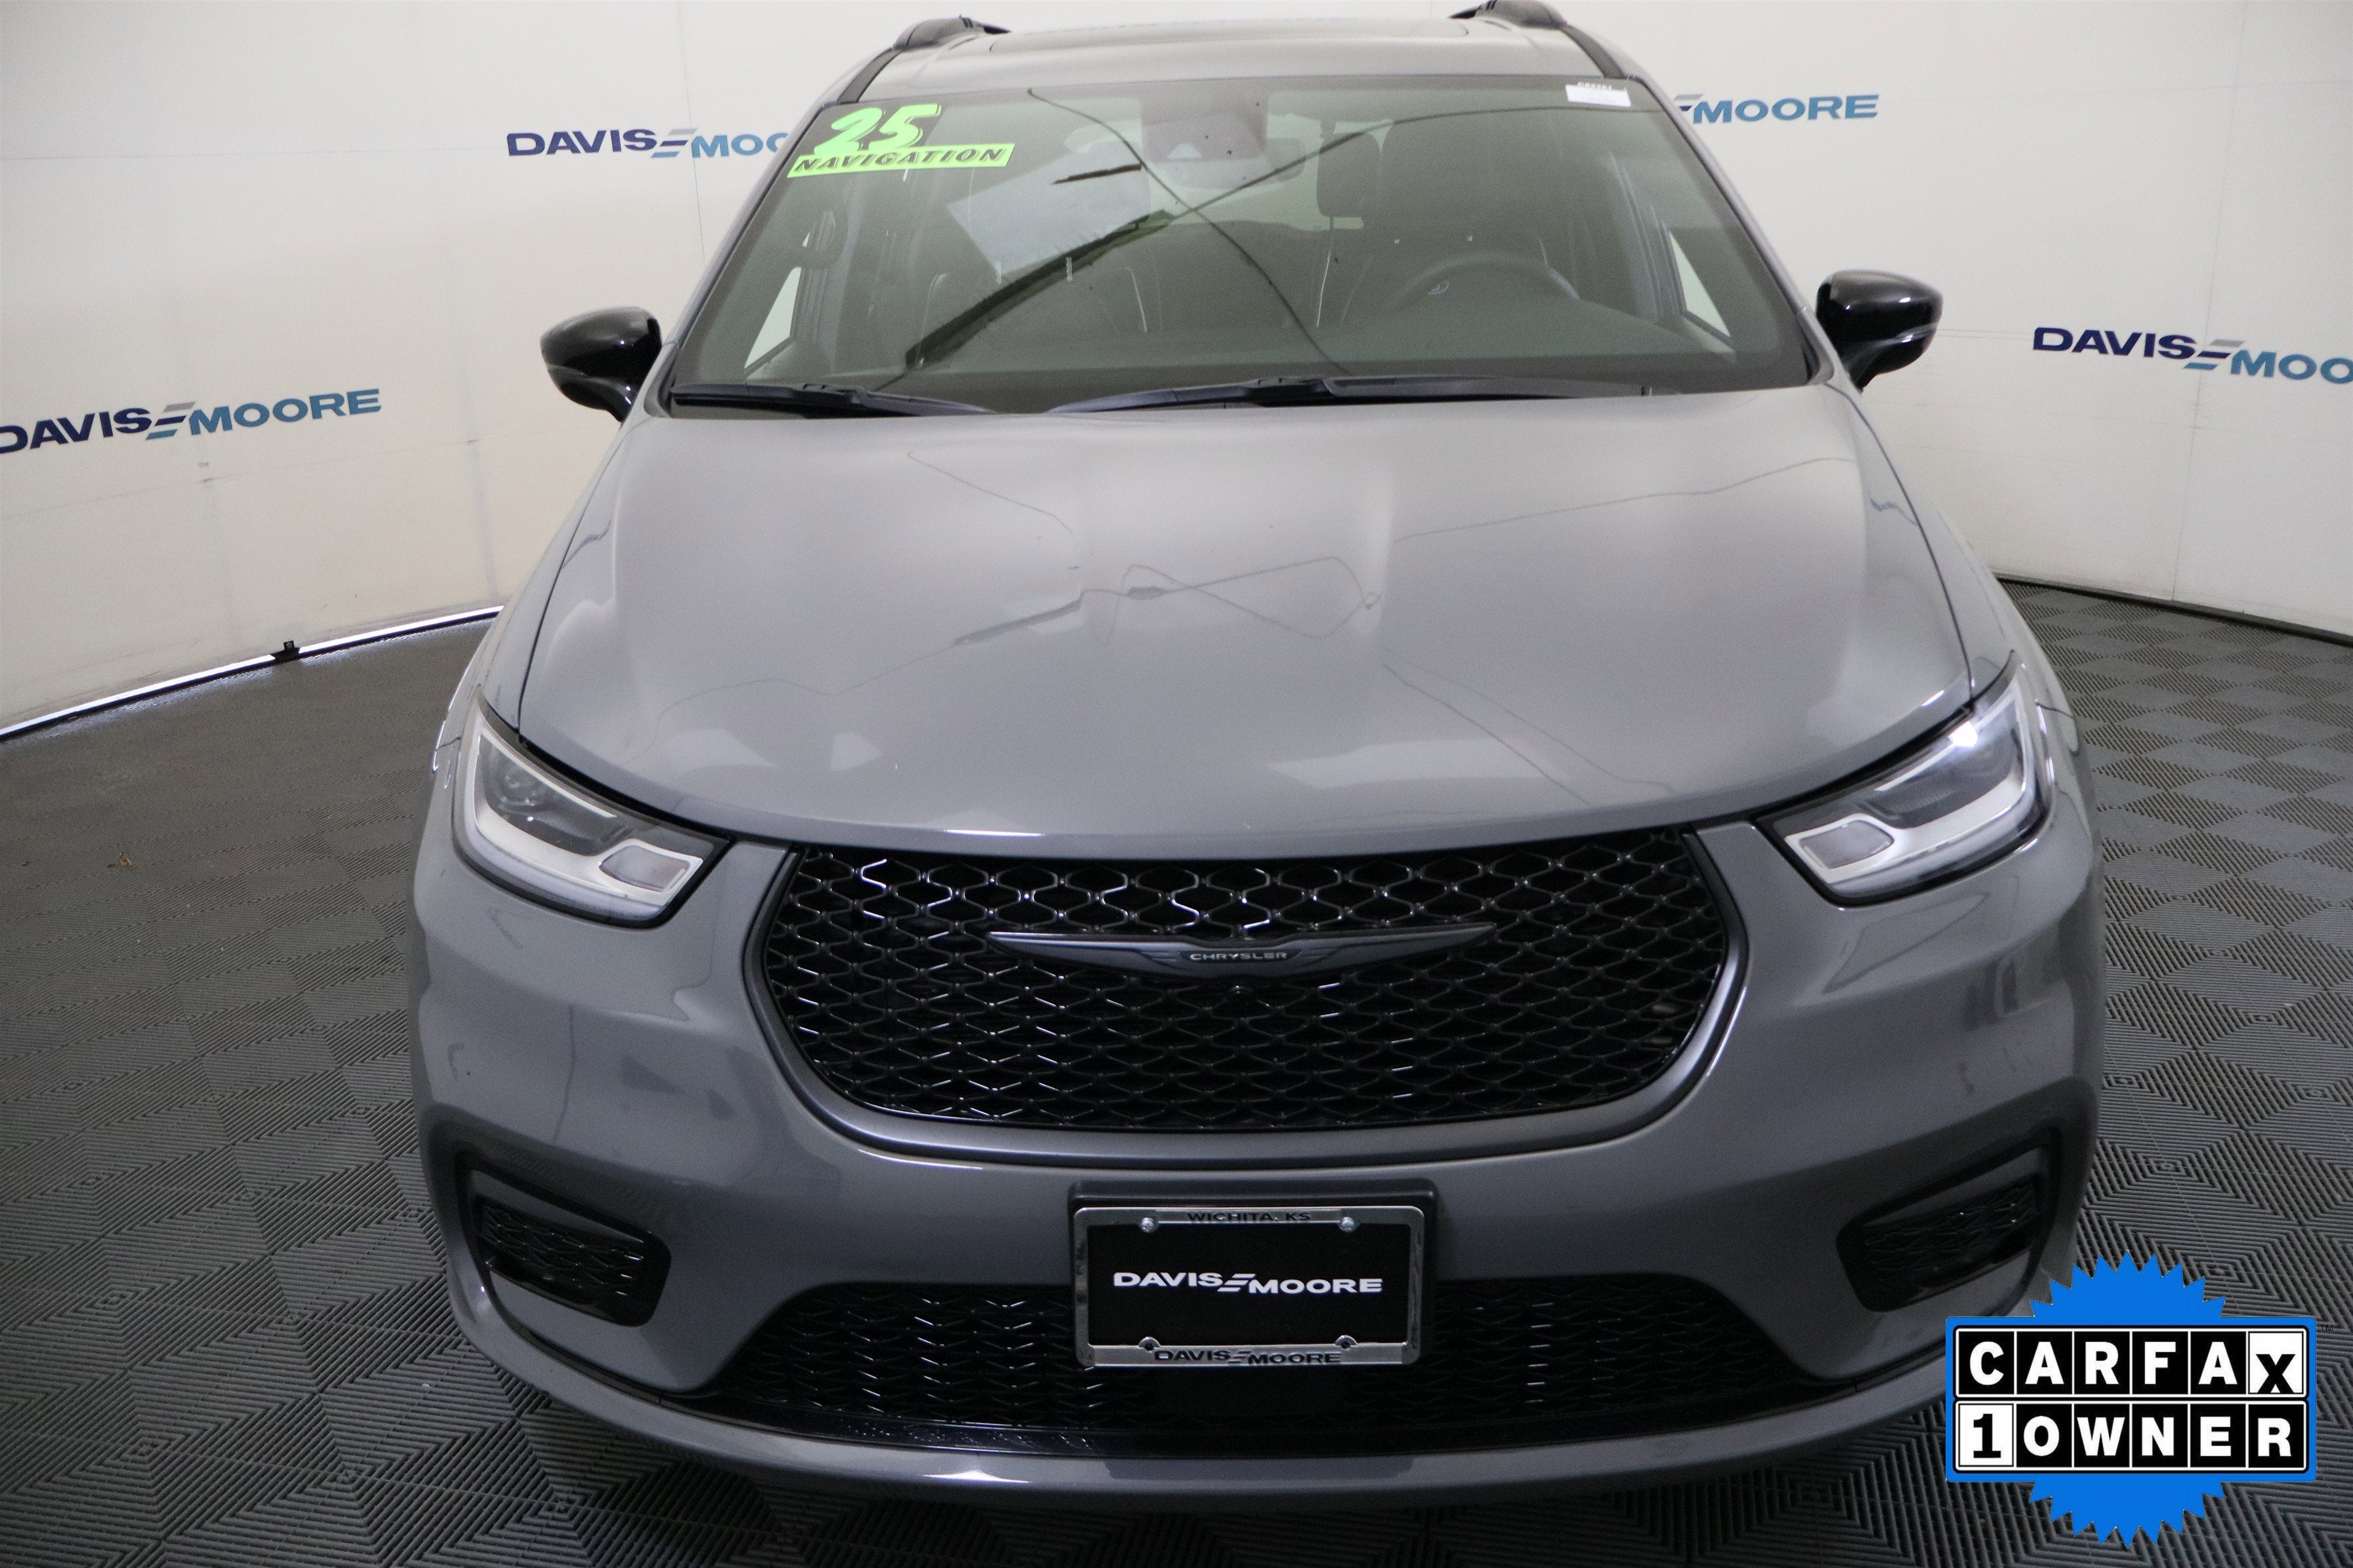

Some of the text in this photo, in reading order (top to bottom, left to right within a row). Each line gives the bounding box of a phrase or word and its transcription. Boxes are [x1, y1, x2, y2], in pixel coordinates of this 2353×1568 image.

[1692, 94, 1879, 124] MOORE
[814, 103, 942, 155] 25
[507, 129, 657, 156] DAVIS
[794, 148, 1005, 172] NAVIGATION
[2033, 326, 2197, 360] DAVIS
[189, 388, 381, 435] MOORE
[1190, 952, 1287, 961] CHRYSLER
[1285, 1212, 1311, 1221] KS
[1113, 1272, 1383, 1294] DAVIS MOORE
[1154, 1349, 1342, 1365] DAVIS MOORE
